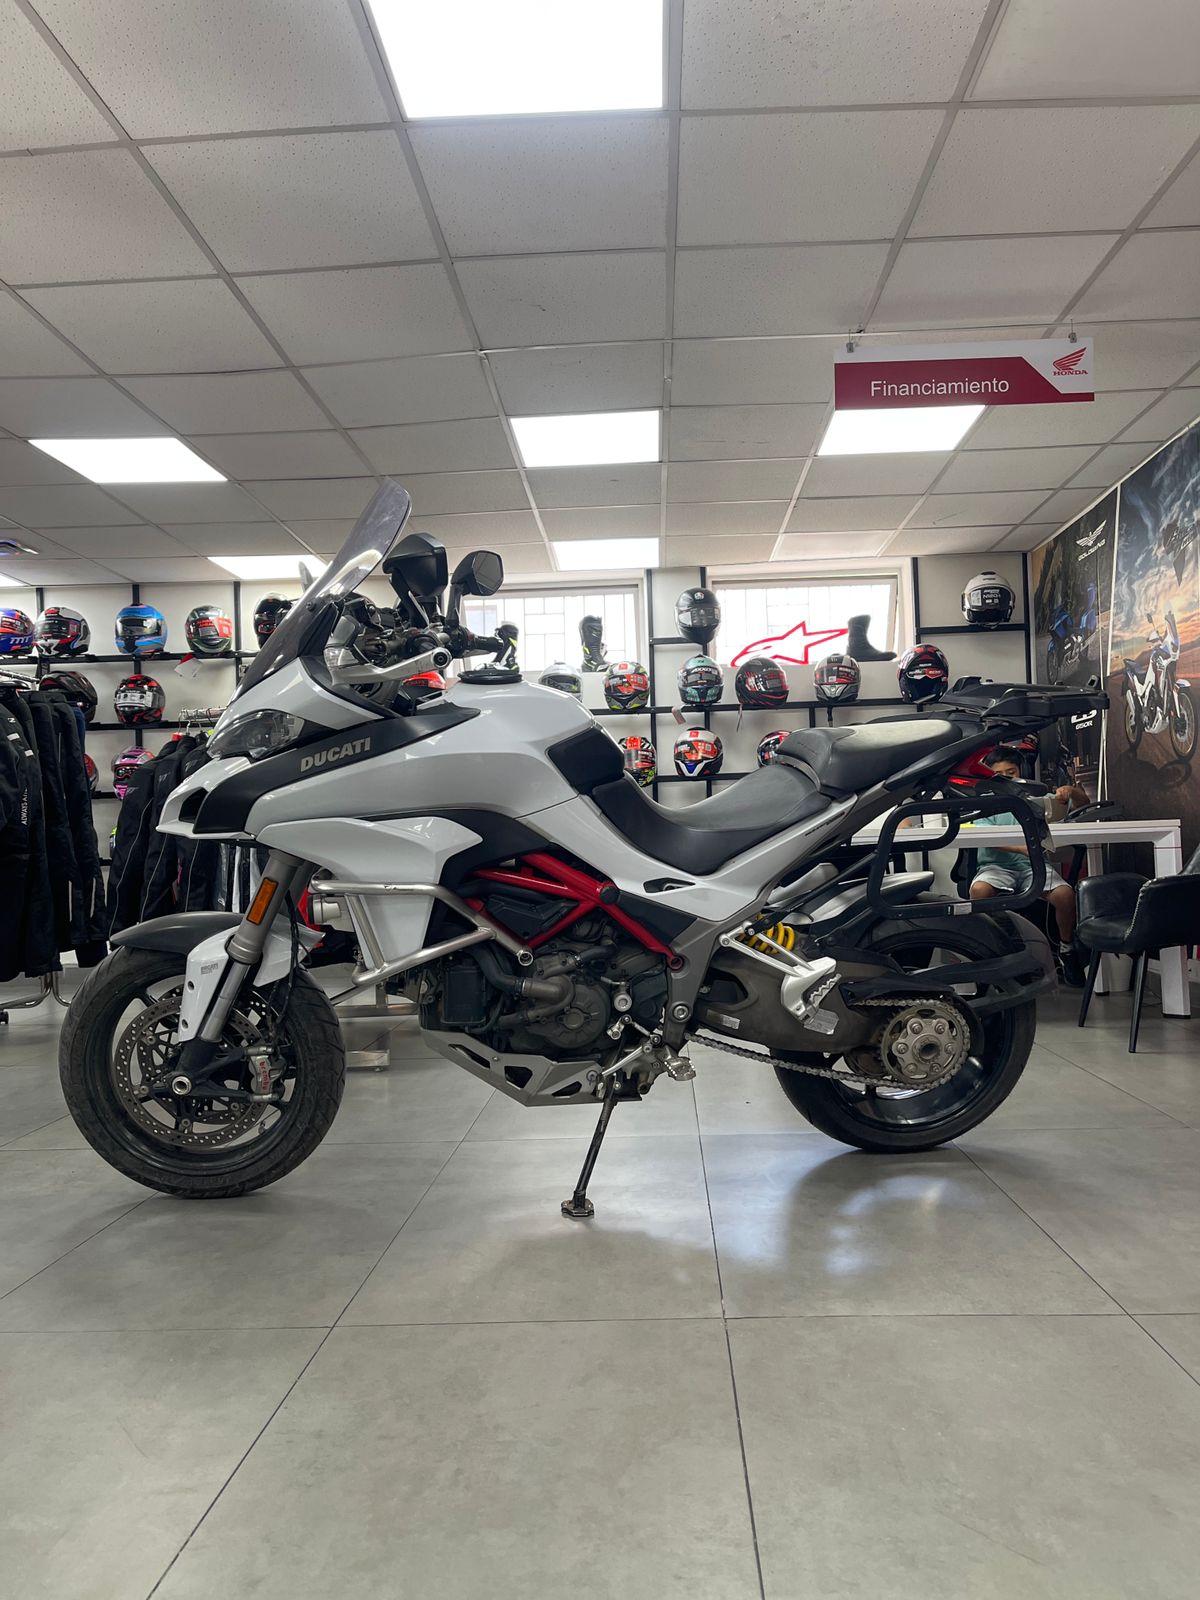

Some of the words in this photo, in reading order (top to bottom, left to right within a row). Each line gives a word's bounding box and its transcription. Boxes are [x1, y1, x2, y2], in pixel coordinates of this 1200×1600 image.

[870, 377, 1010, 397] Financiamiento
[300, 737, 371, 772] DUCATI
[260, 1060, 270, 1089] brembo
